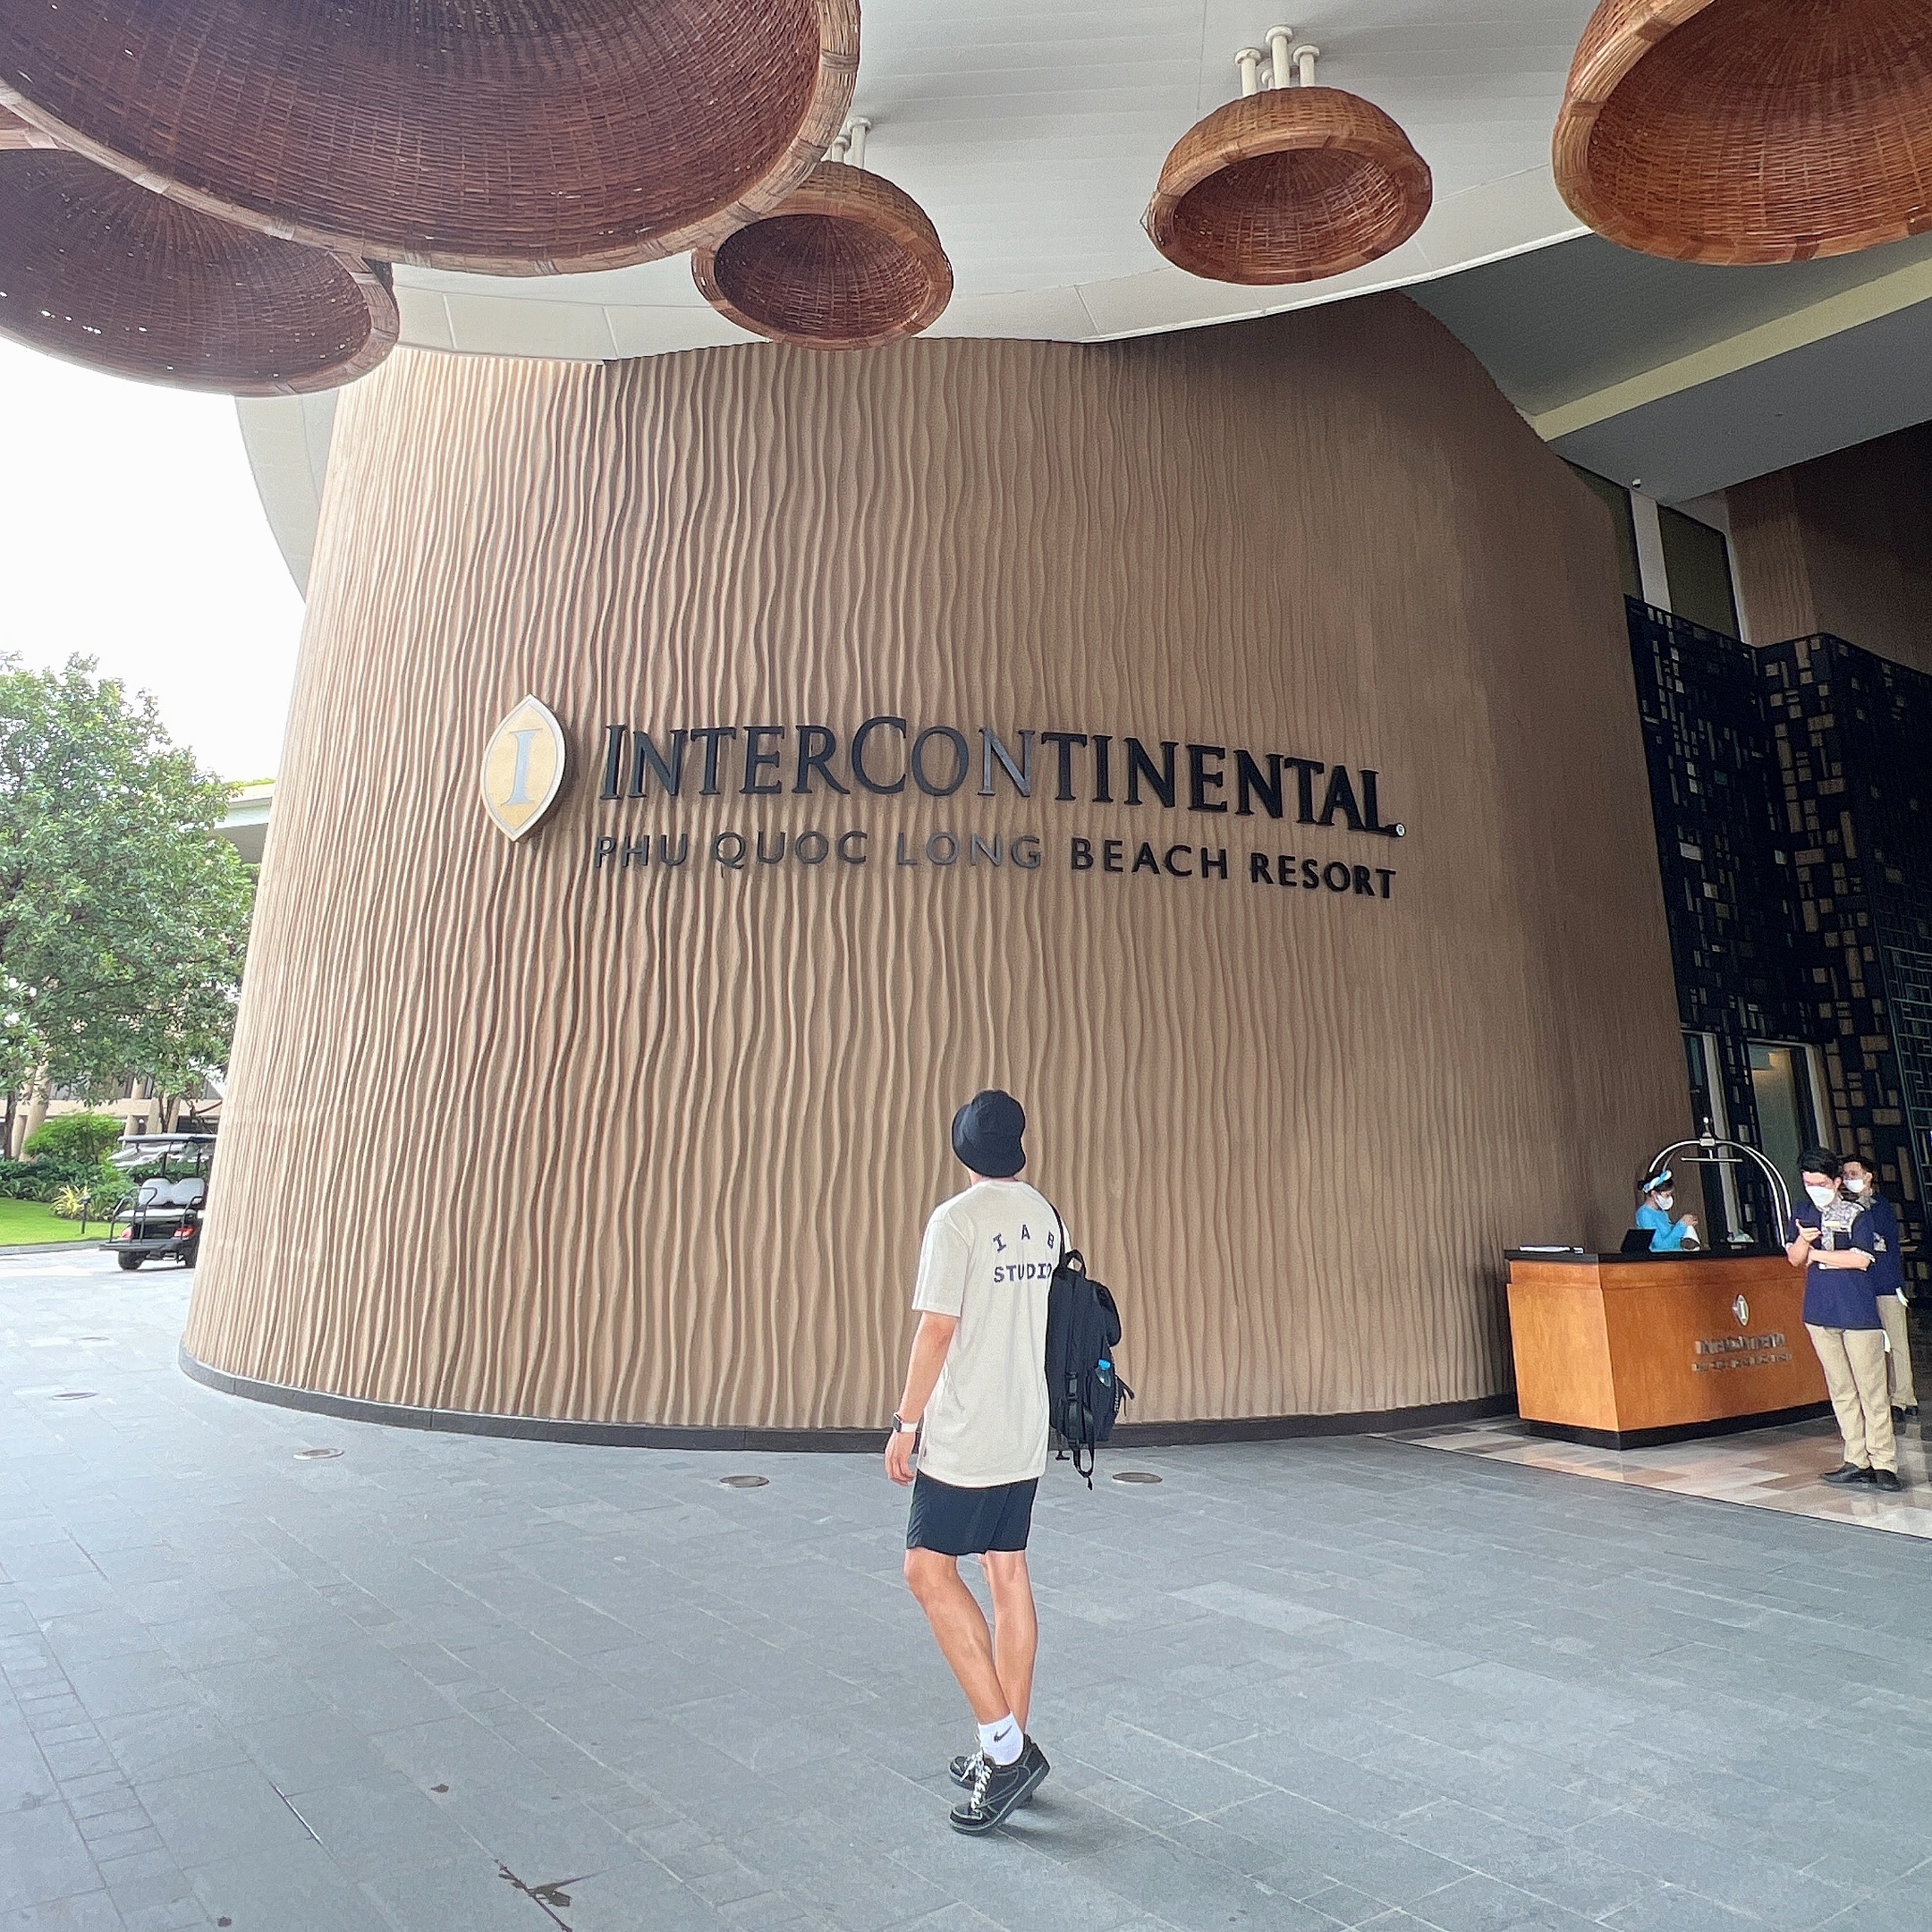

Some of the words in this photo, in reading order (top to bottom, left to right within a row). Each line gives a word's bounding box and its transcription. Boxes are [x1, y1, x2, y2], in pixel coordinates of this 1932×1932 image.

[599, 716, 1396, 837] INTERCONTINENTAL
[594, 833, 688, 868] PHU
[715, 831, 868, 869] QUOC
[897, 832, 1042, 869] LONG
[1072, 837, 1229, 880] BEACH
[1251, 852, 1397, 899] RESORT
